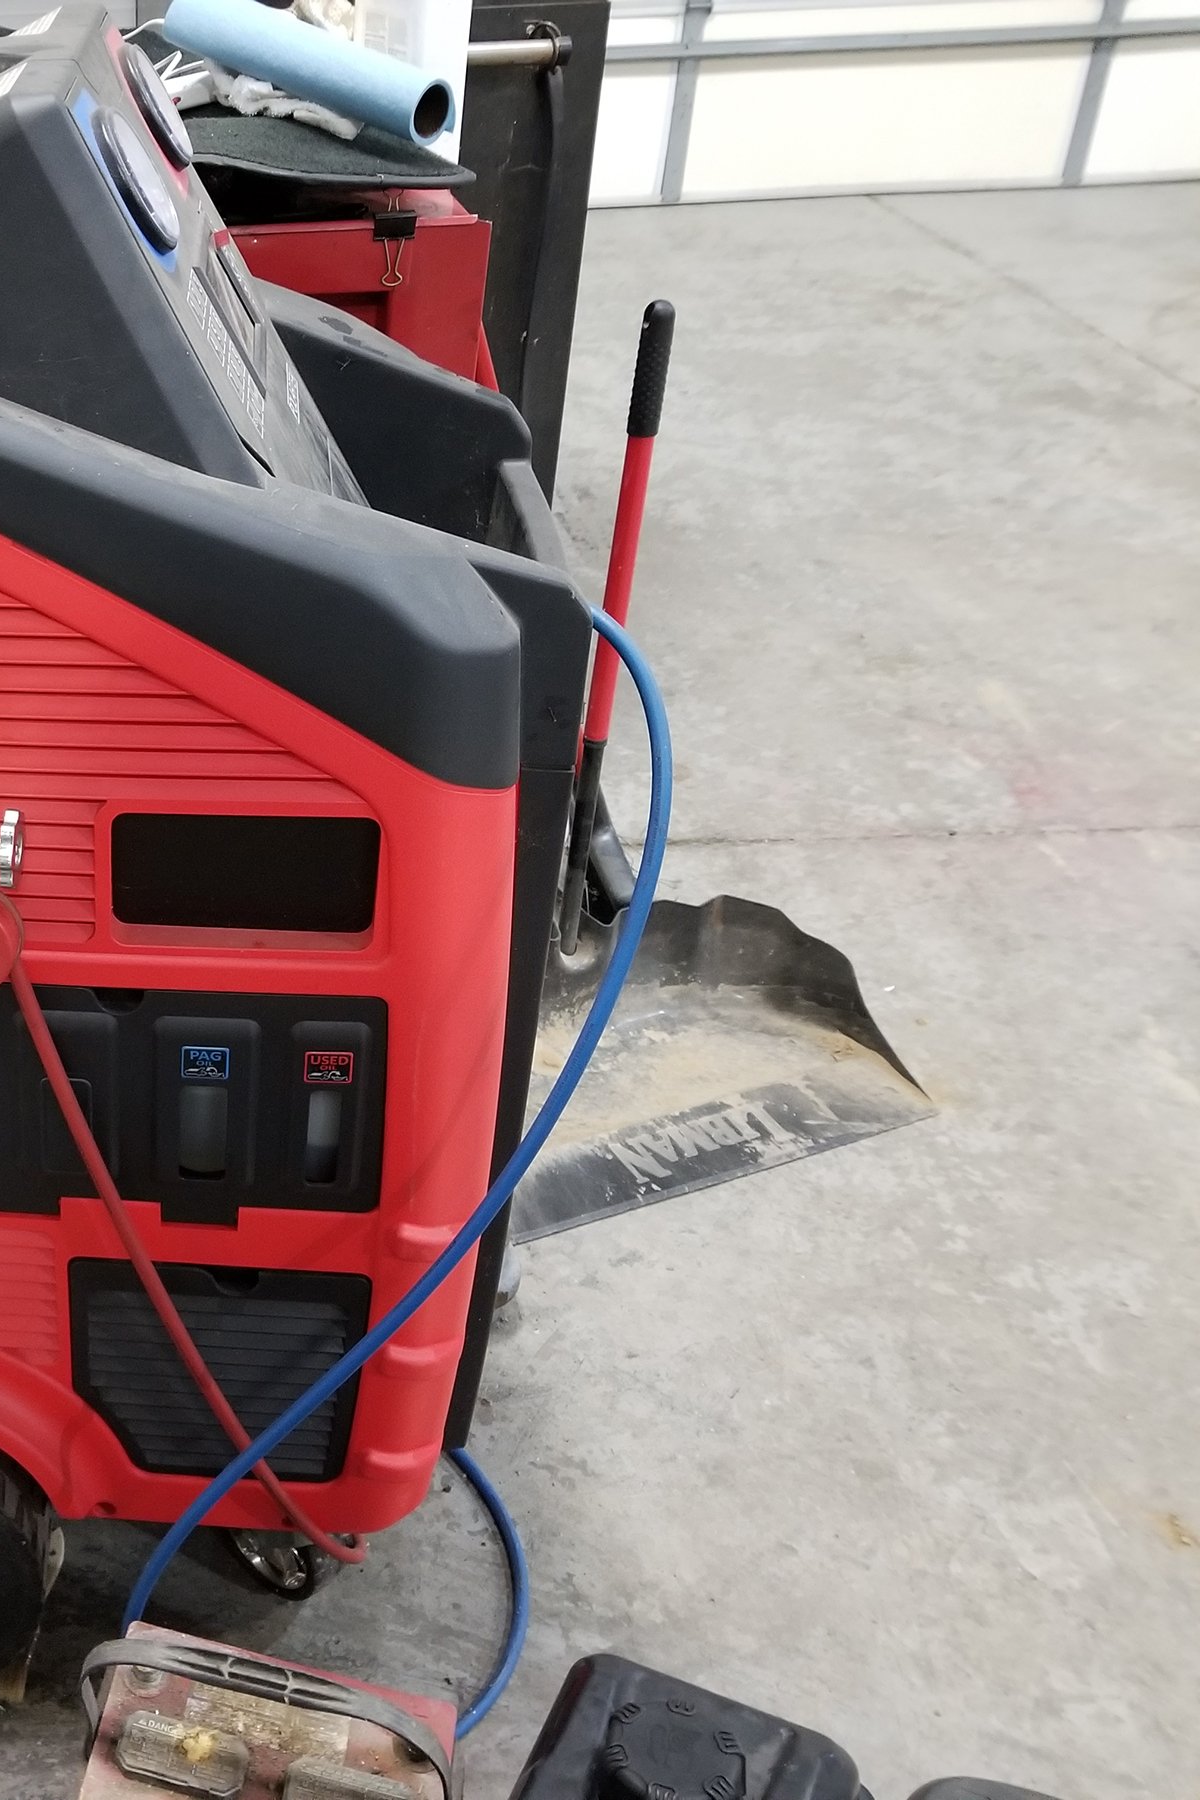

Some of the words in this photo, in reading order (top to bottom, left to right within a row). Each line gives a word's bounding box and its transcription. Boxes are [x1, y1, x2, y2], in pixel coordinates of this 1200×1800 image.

[190, 1050, 222, 1061] PAG
[310, 1055, 349, 1066] USED
[607, 1101, 798, 1184] LIBMAN
